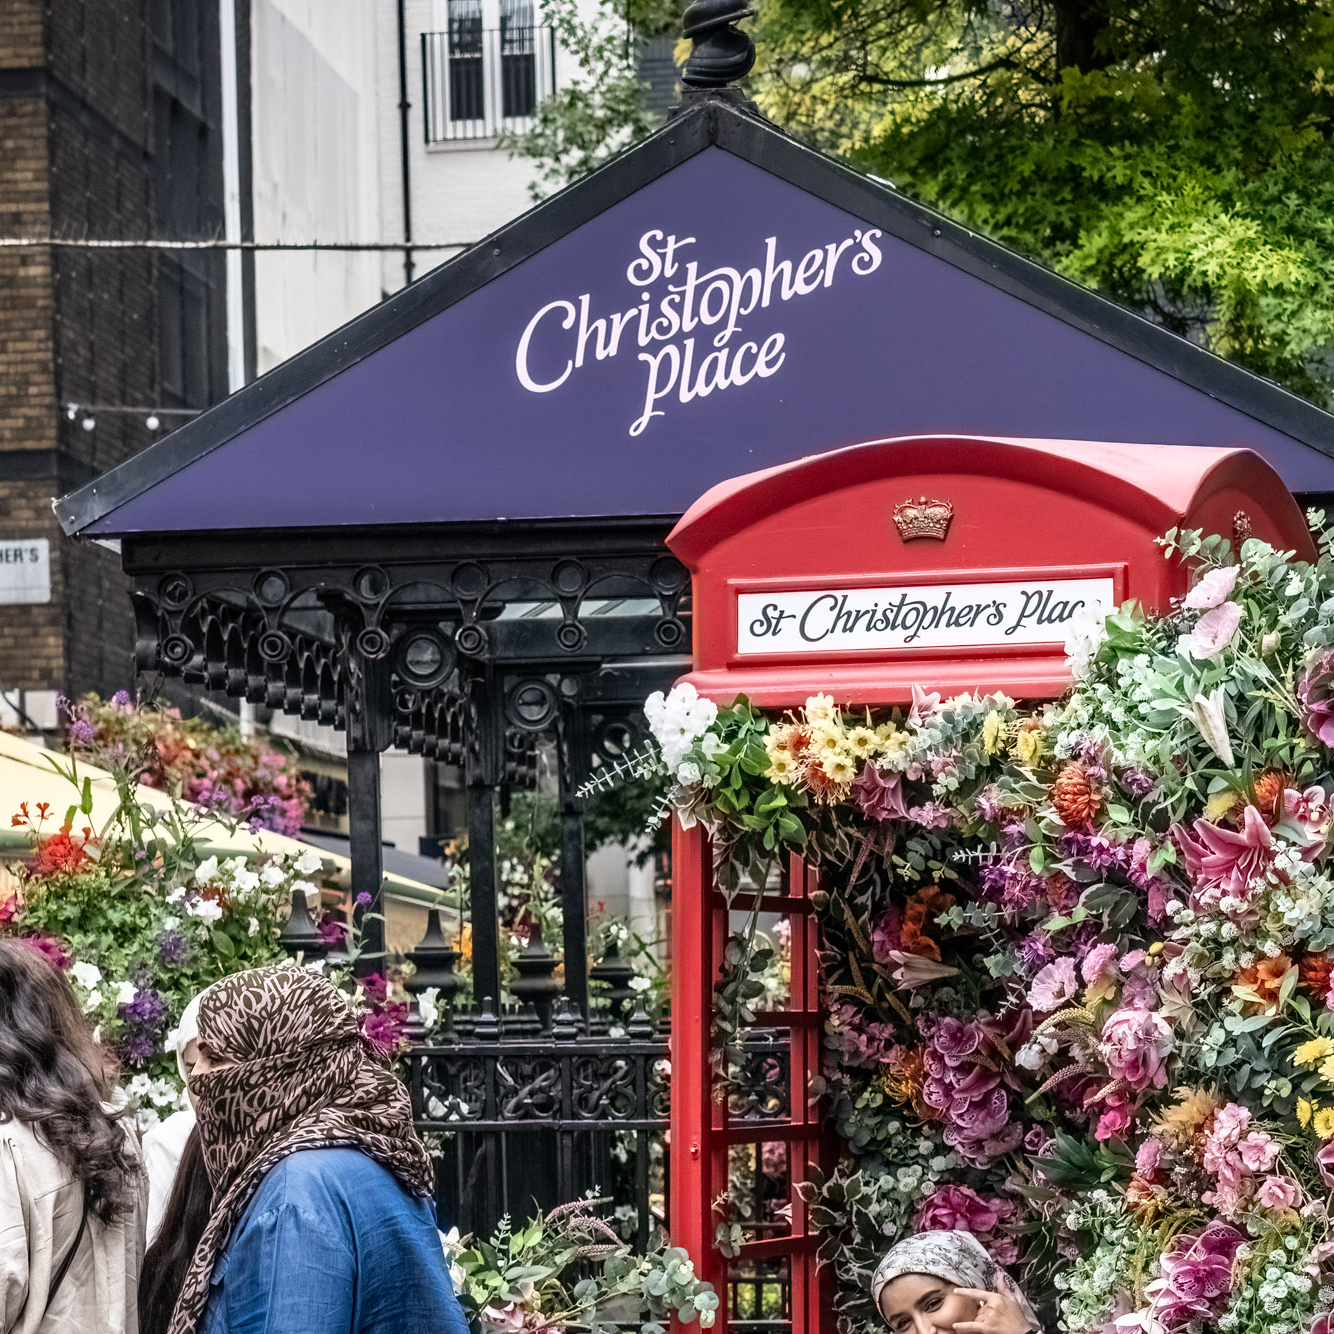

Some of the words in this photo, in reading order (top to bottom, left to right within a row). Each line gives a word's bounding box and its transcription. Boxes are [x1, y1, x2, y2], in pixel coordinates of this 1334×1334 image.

[626, 229, 695, 287] St
[515, 229, 884, 393] Christopher's
[628, 332, 786, 437] Place
[749, 602, 796, 637] St
[799, 591, 1007, 645] Christopher's
[1005, 590, 1101, 636] Plac
